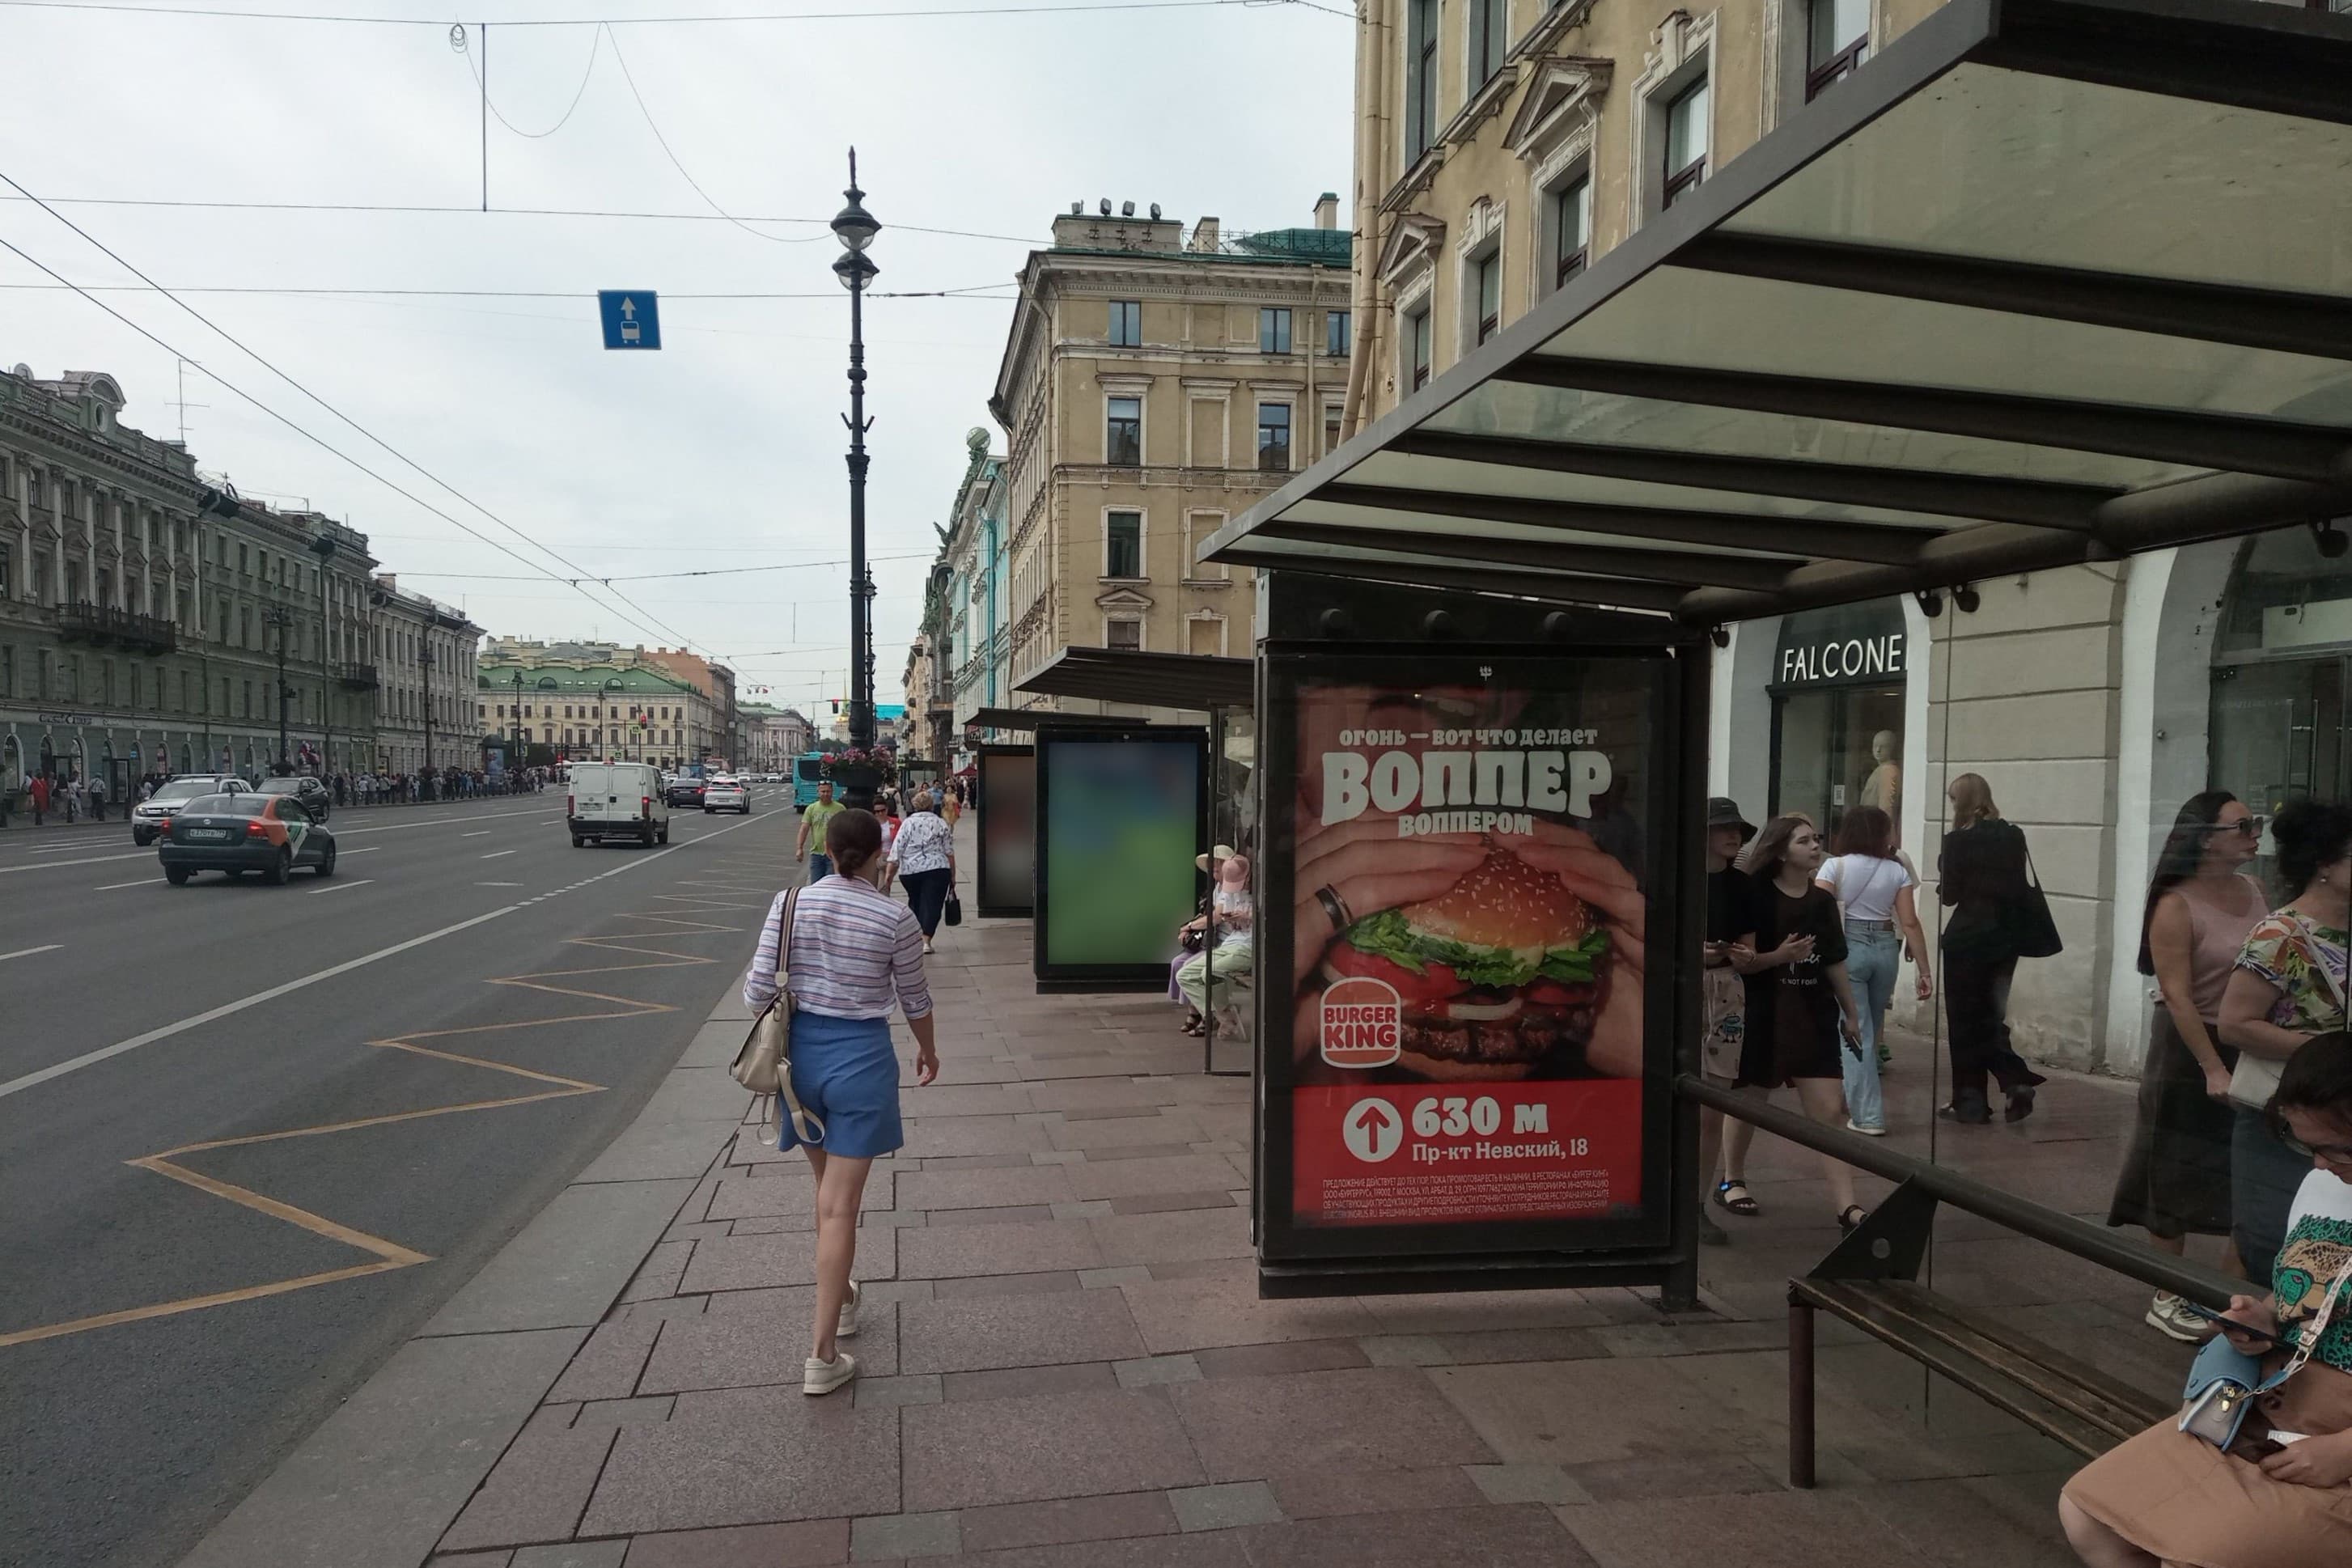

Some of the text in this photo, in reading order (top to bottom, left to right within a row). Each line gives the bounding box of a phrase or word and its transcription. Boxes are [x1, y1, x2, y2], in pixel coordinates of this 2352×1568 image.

[1782, 634, 1908, 682] FALCONE
[1339, 729, 1406, 745] огонь
[1433, 729, 1472, 744] вот
[1475, 729, 1515, 744] что
[1519, 728, 1598, 745] делает
[1321, 751, 1612, 826] ВОППЕР
[1398, 812, 1533, 837] ВОППЕРОМ
[1324, 1006, 1396, 1023] BURGER
[1324, 1024, 1396, 1049] KING
[1412, 1096, 1501, 1137] 630
[1412, 1138, 1588, 1165] Пр-кт Невский, 18
